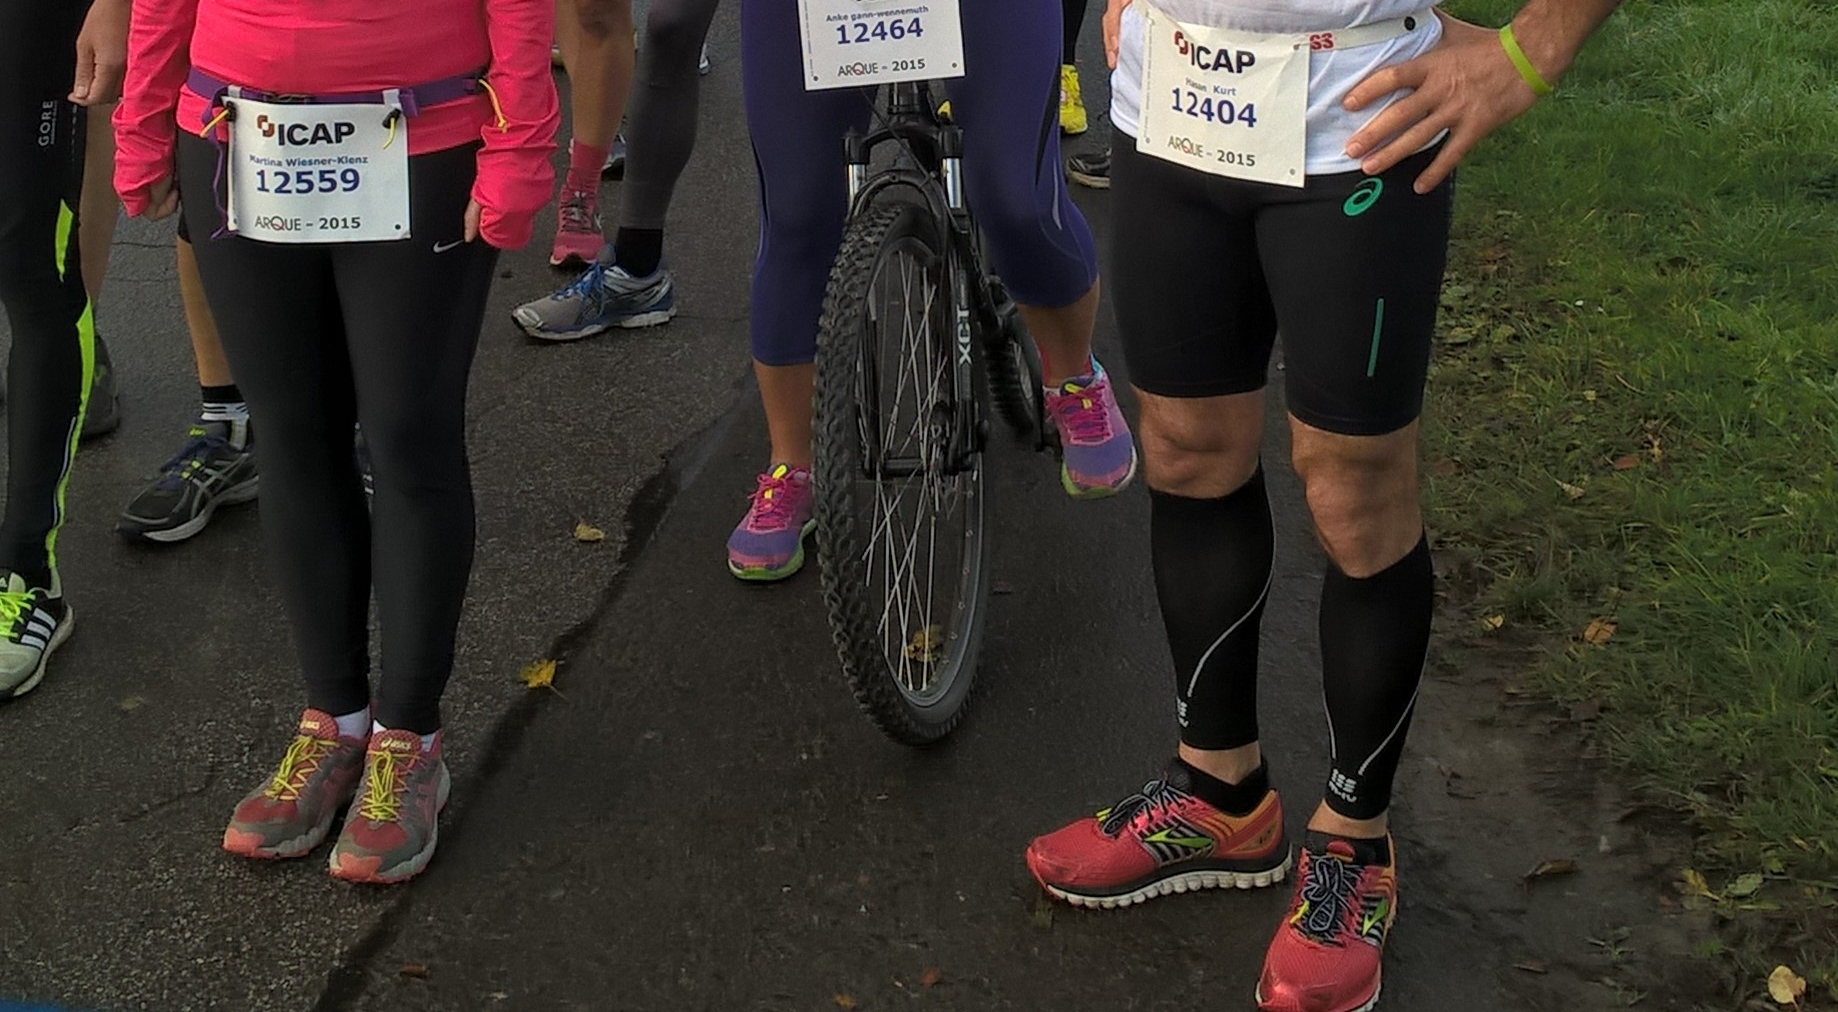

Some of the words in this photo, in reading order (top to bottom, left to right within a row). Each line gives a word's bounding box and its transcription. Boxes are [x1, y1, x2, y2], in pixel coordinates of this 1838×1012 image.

[826, 13, 849, 22] Anke
[836, 17, 924, 45] 12464
[837, 62, 879, 77] ARQUE
[891, 58, 926, 72] 2015
[1190, 43, 1256, 74] ICAP
[1213, 85, 1237, 96] Kurt
[1171, 87, 1257, 128] 12404
[37, 100, 54, 146] GORE
[278, 122, 355, 146] ICAP
[249, 154, 283, 167] Martina
[285, 155, 368, 167] Wiesner-Klenz
[1167, 135, 1204, 158] ARQUE
[1217, 149, 1256, 167] 2015
[256, 168, 360, 194] 12559
[254, 215, 302, 231] ARQUE
[319, 216, 361, 230] 2015
[956, 304, 971, 365] XCT
